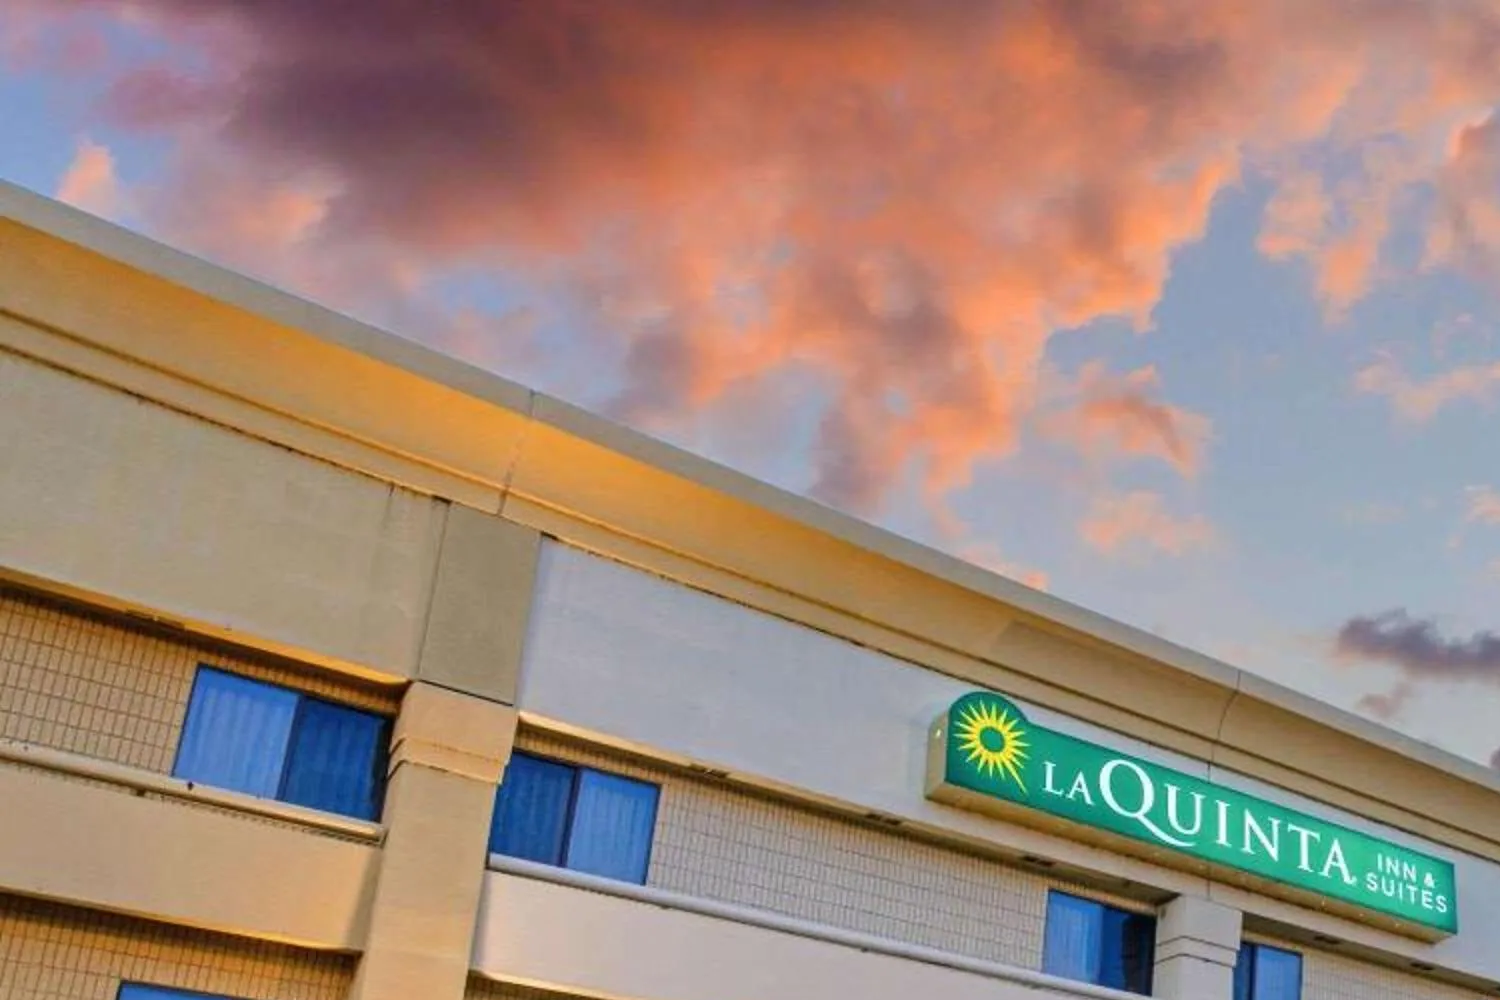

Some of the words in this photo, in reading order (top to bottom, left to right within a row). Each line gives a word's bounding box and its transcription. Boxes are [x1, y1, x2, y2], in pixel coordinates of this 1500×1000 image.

[1042, 760, 1095, 806] LA
[1099, 759, 1357, 885] QUINTA
[1377, 853, 1417, 883] INN
[1366, 871, 1448, 913] SUITES
